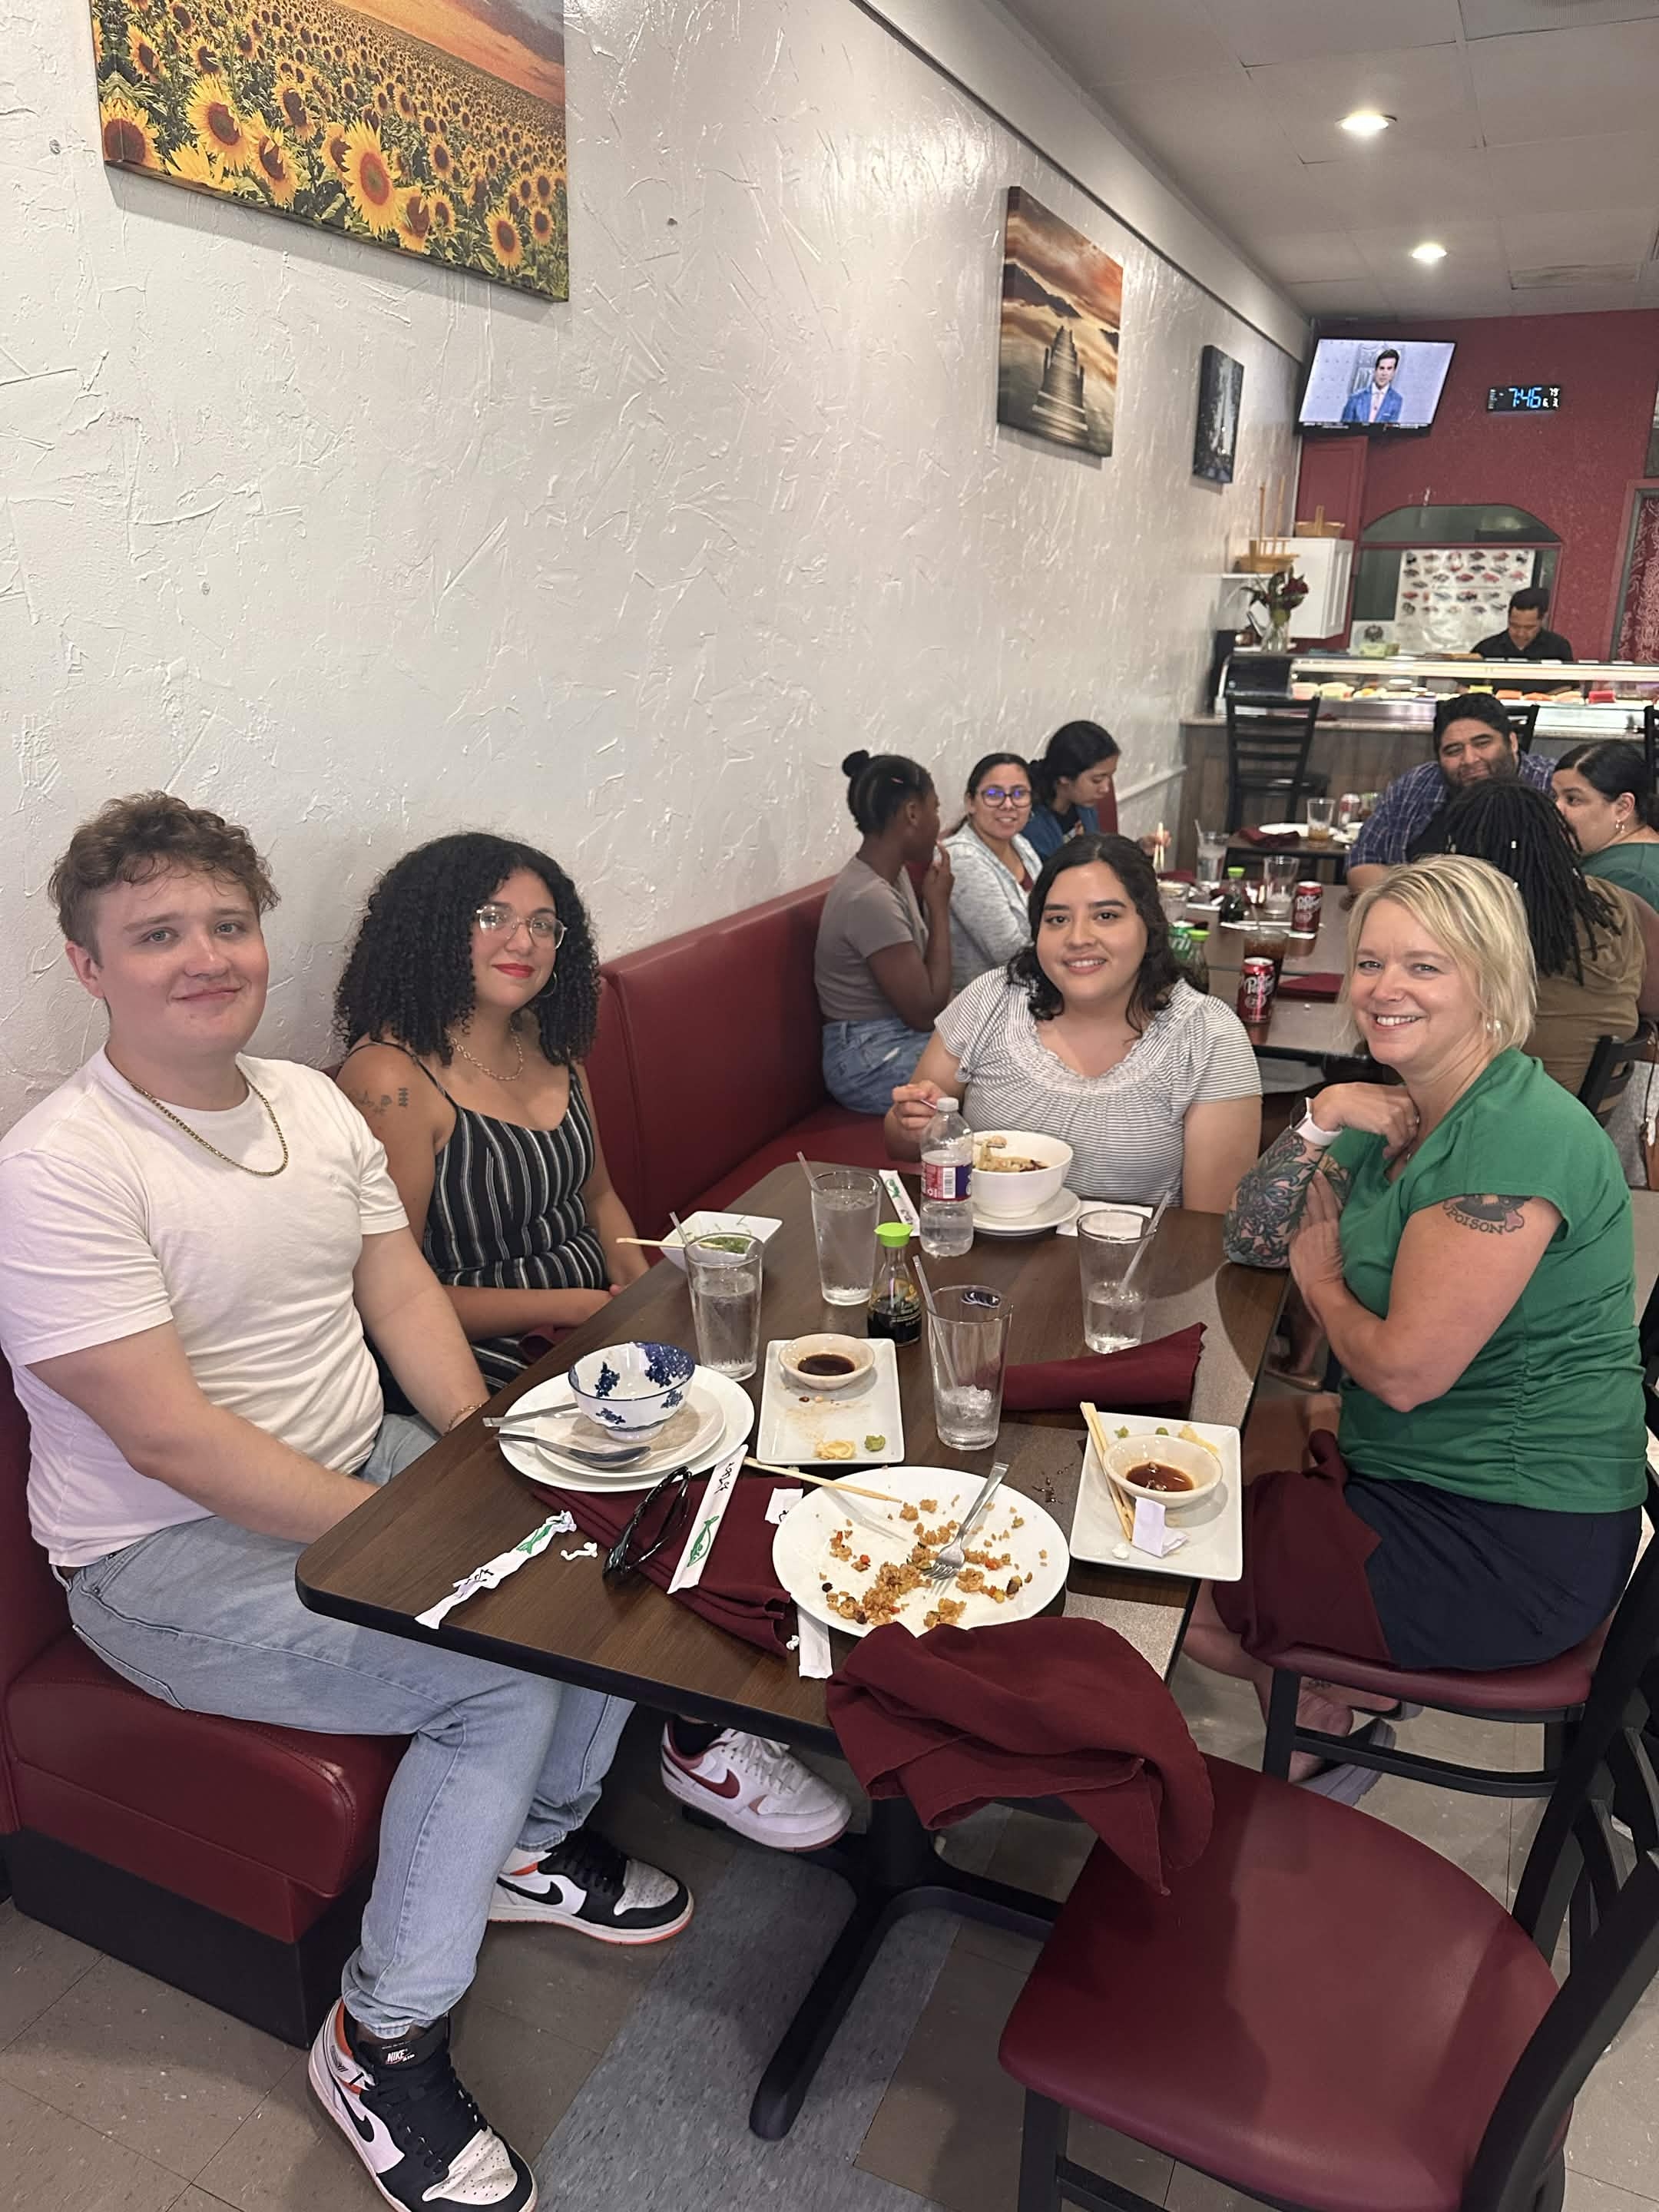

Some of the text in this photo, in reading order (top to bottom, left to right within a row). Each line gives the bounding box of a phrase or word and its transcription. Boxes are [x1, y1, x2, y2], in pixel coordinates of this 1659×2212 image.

[1508, 388, 1542, 408] 7:46
[1445, 1208, 1504, 1235] POISON
[387, 2049, 406, 2062] NIKE
